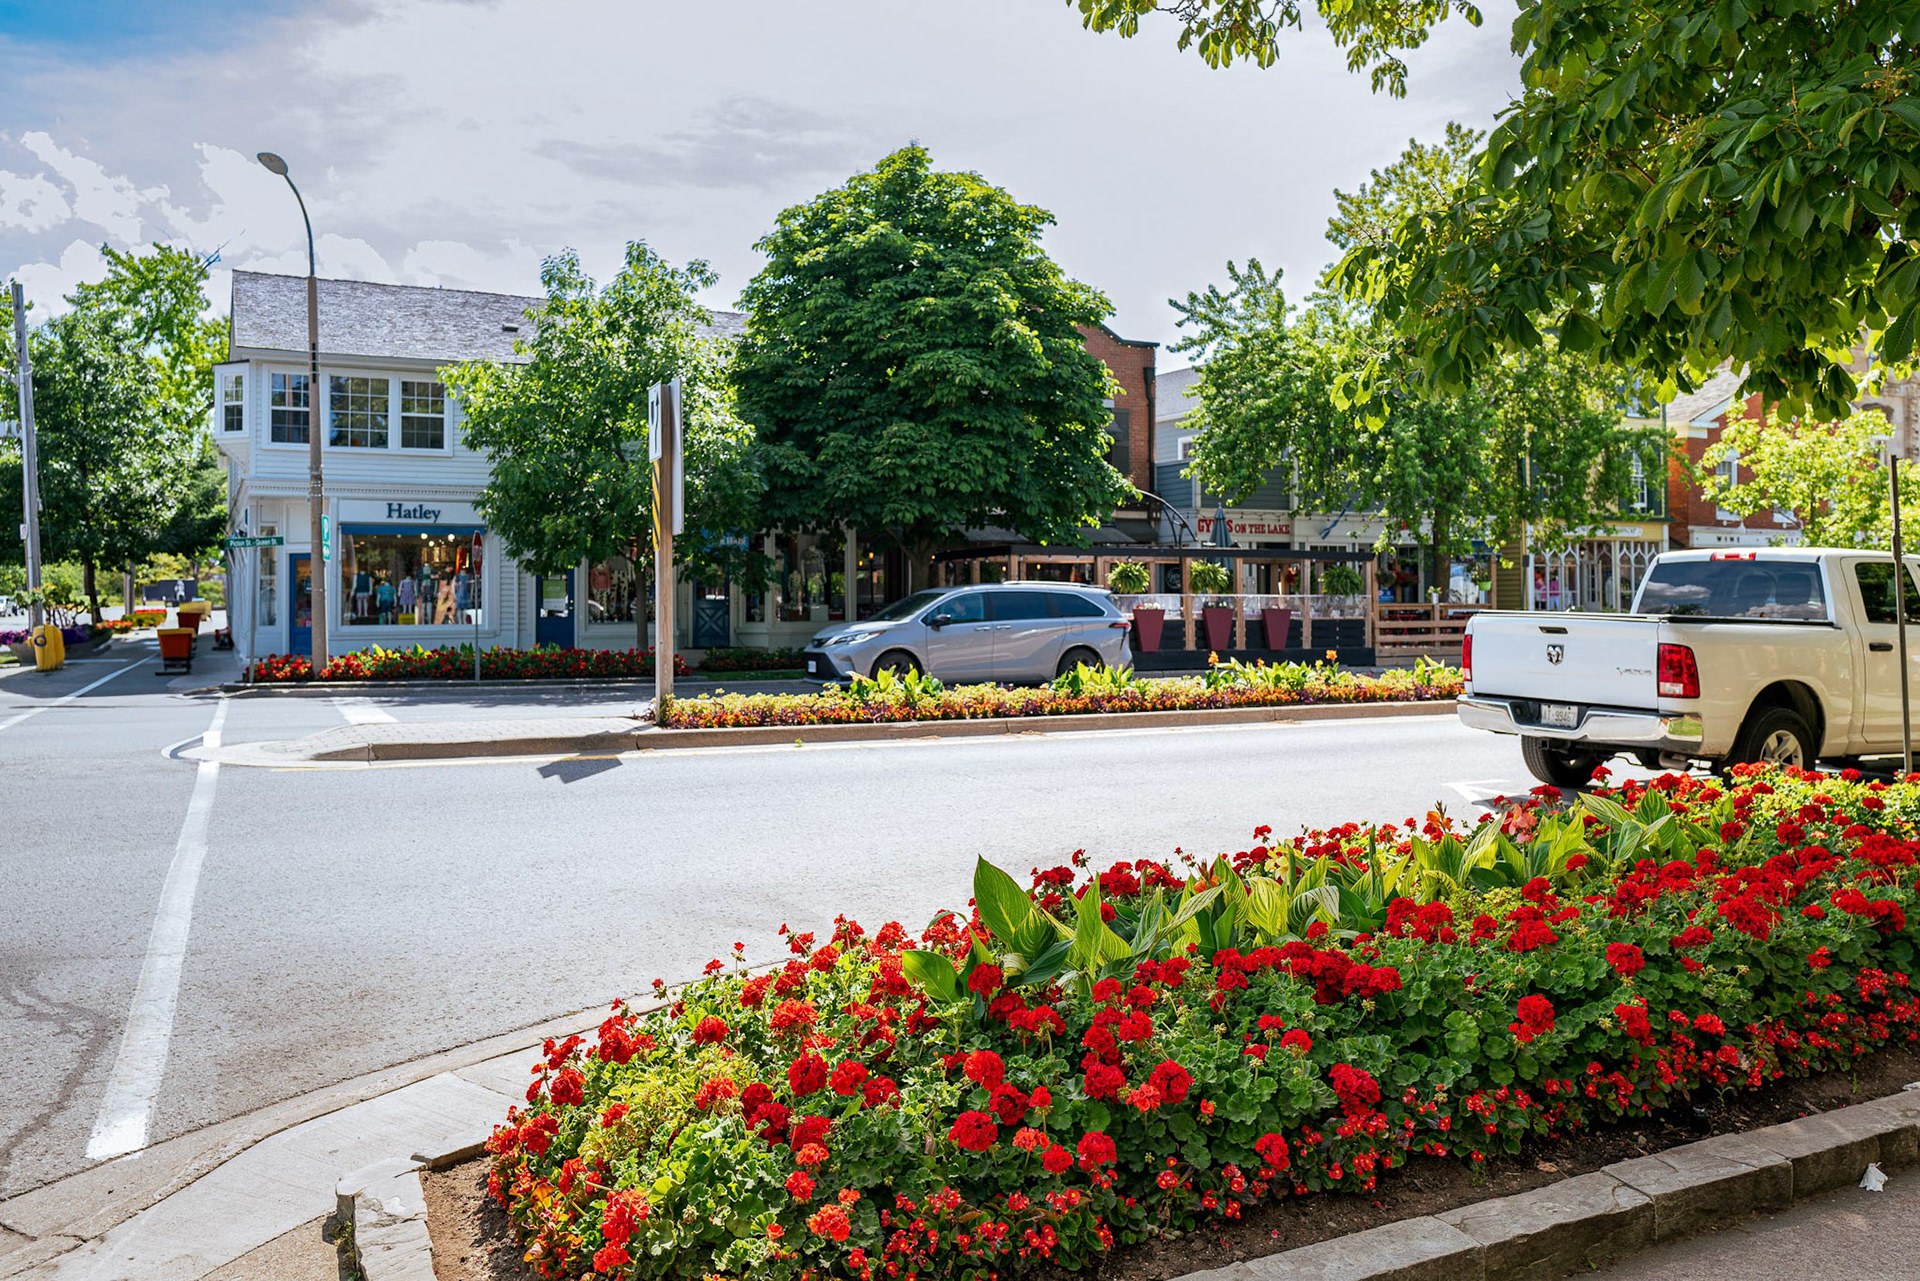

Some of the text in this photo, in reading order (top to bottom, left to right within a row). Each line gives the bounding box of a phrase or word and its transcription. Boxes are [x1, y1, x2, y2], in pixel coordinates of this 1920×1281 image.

[386, 502, 441, 524] Hatley
[1197, 518, 1290, 535] GYS ON THE LAKE
[256, 538, 271, 546] Queen
